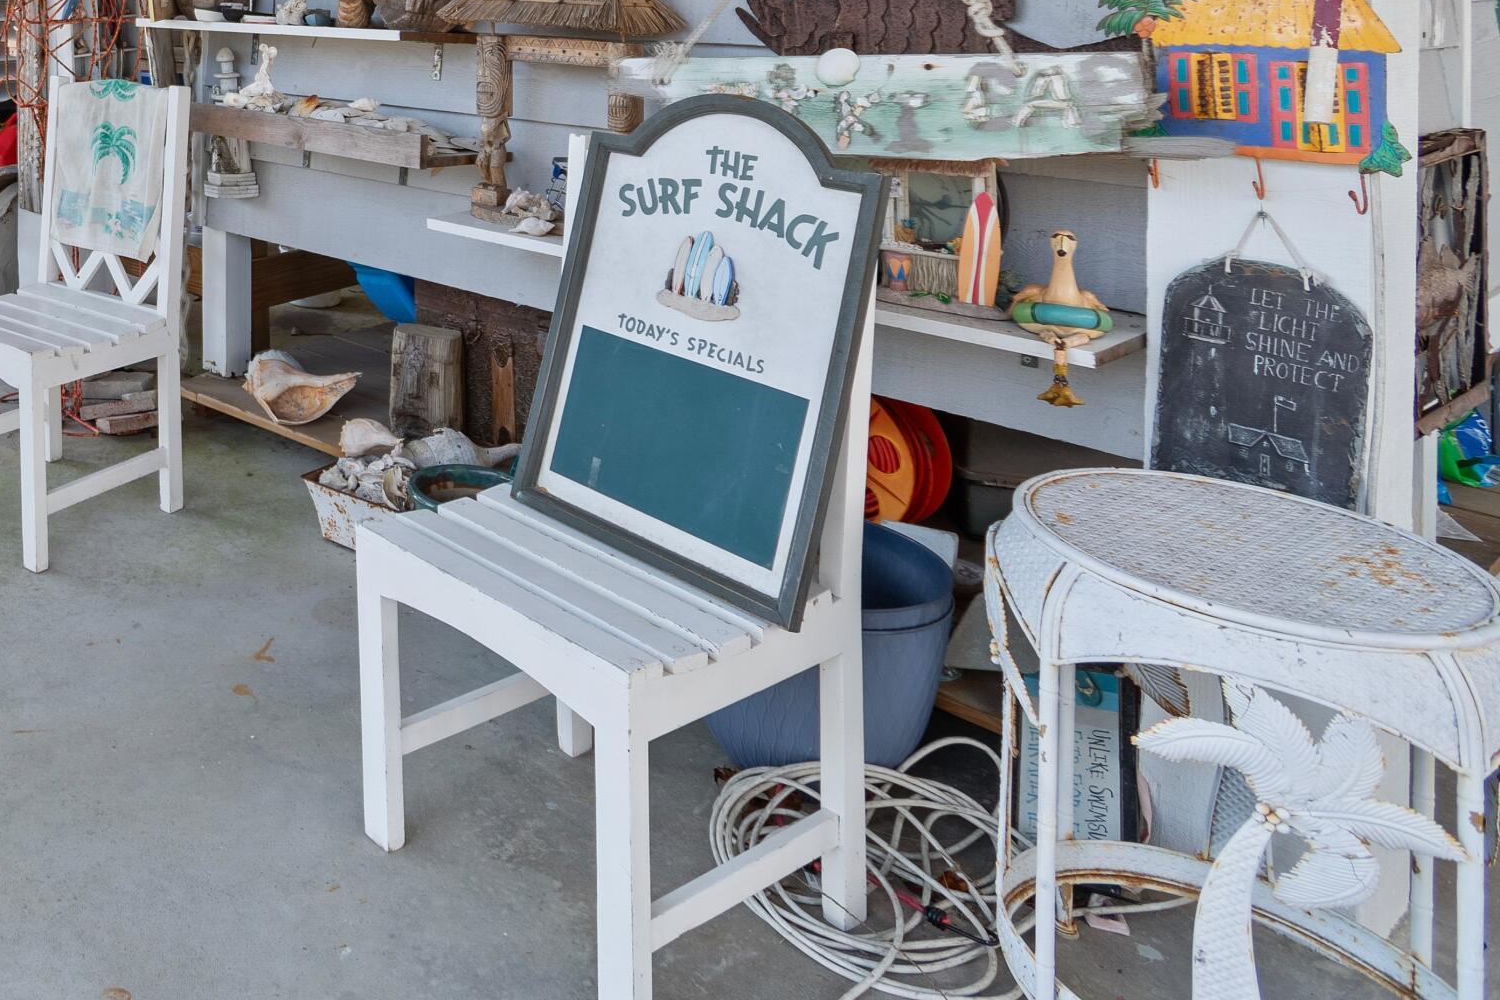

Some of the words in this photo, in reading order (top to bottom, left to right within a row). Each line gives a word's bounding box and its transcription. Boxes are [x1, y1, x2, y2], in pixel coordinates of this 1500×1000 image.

[706, 145, 759, 181] THE
[618, 177, 703, 218] SURF
[714, 182, 840, 271] SHACK
[1249, 288, 1287, 311] LET
[1303, 298, 1342, 323] THE
[617, 313, 680, 346] TODAY'S
[687, 337, 765, 374] SPECIALS
[1244, 331, 1313, 363] SHINE
[1315, 350, 1360, 373] AND
[1252, 354, 1346, 392] PROTECT
[1086, 730, 1112, 780] UNLIKE
